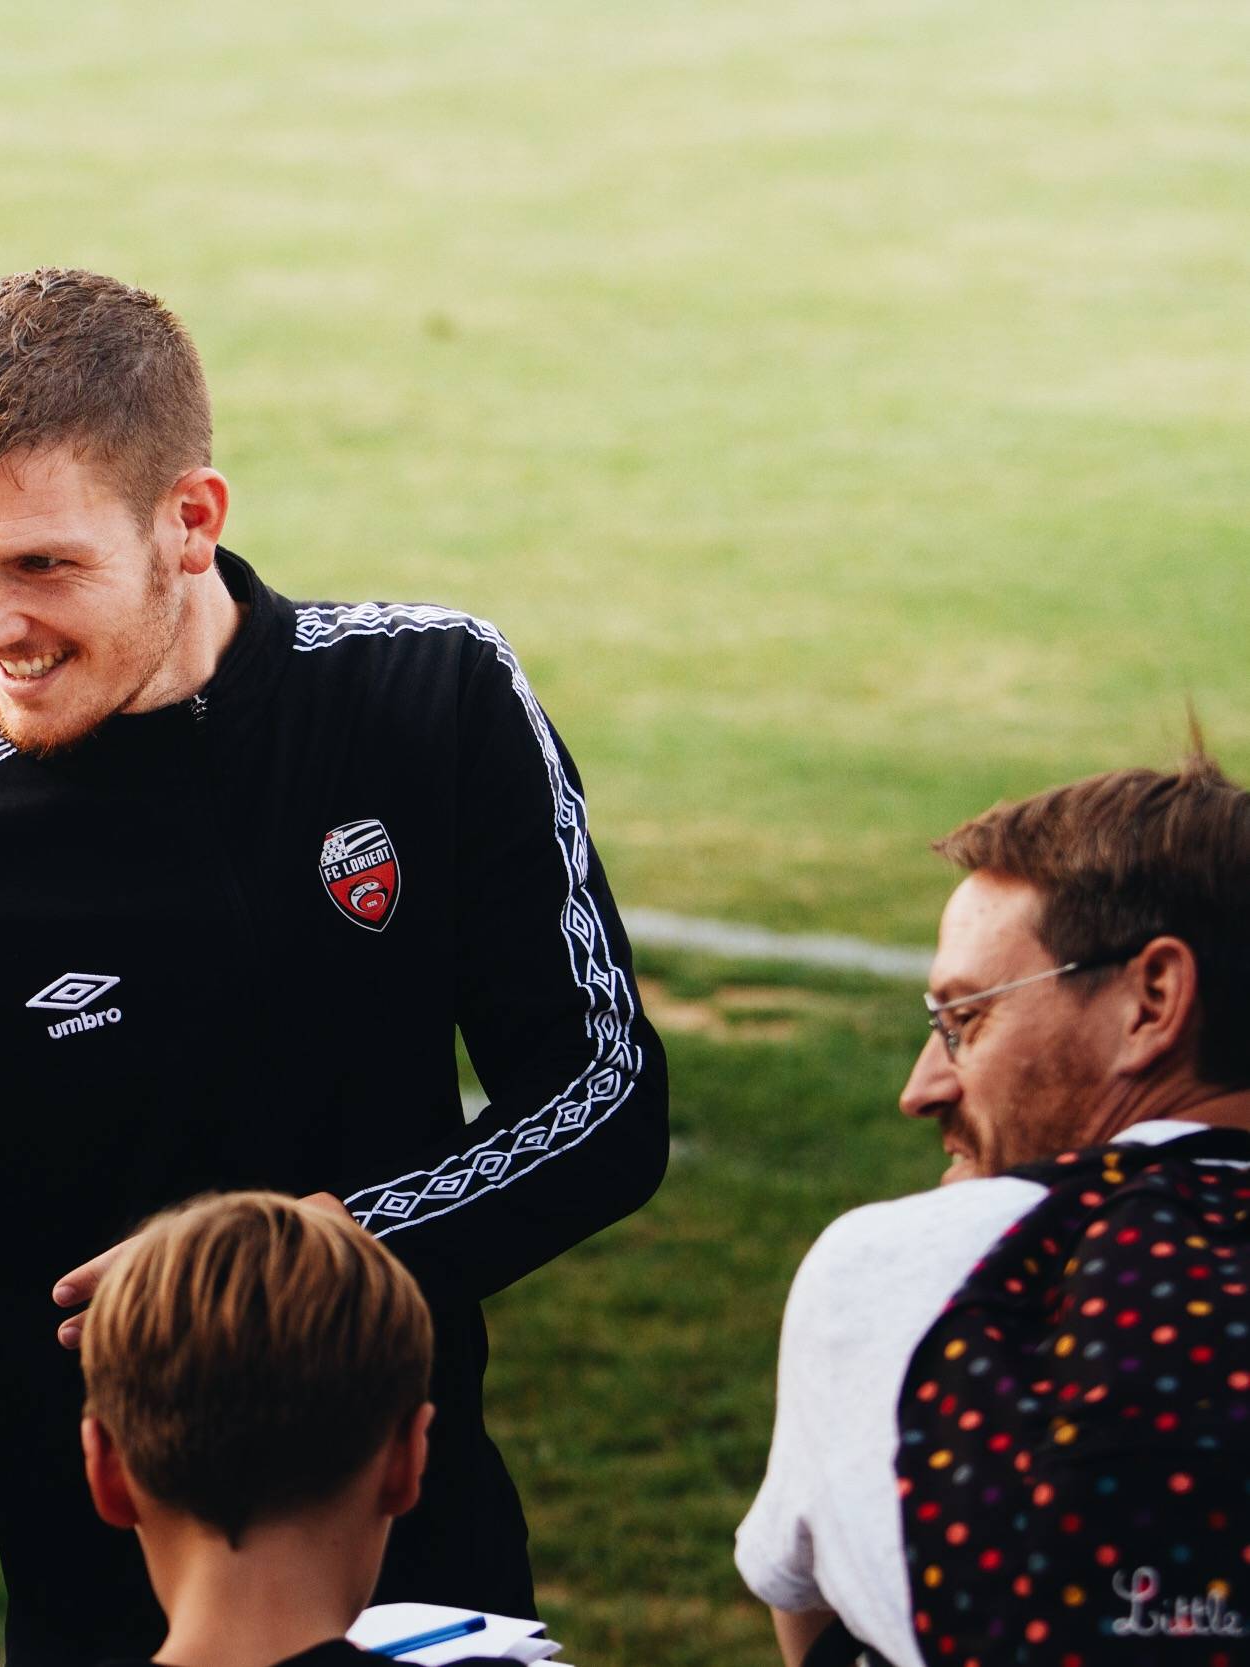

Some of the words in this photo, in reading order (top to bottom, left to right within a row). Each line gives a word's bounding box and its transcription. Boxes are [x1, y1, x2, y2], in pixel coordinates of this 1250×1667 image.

[323, 864, 342, 882] FC
[342, 845, 391, 876] LORIENT
[47, 1007, 122, 1039] umbro
[1111, 1565, 1243, 1638] Little
